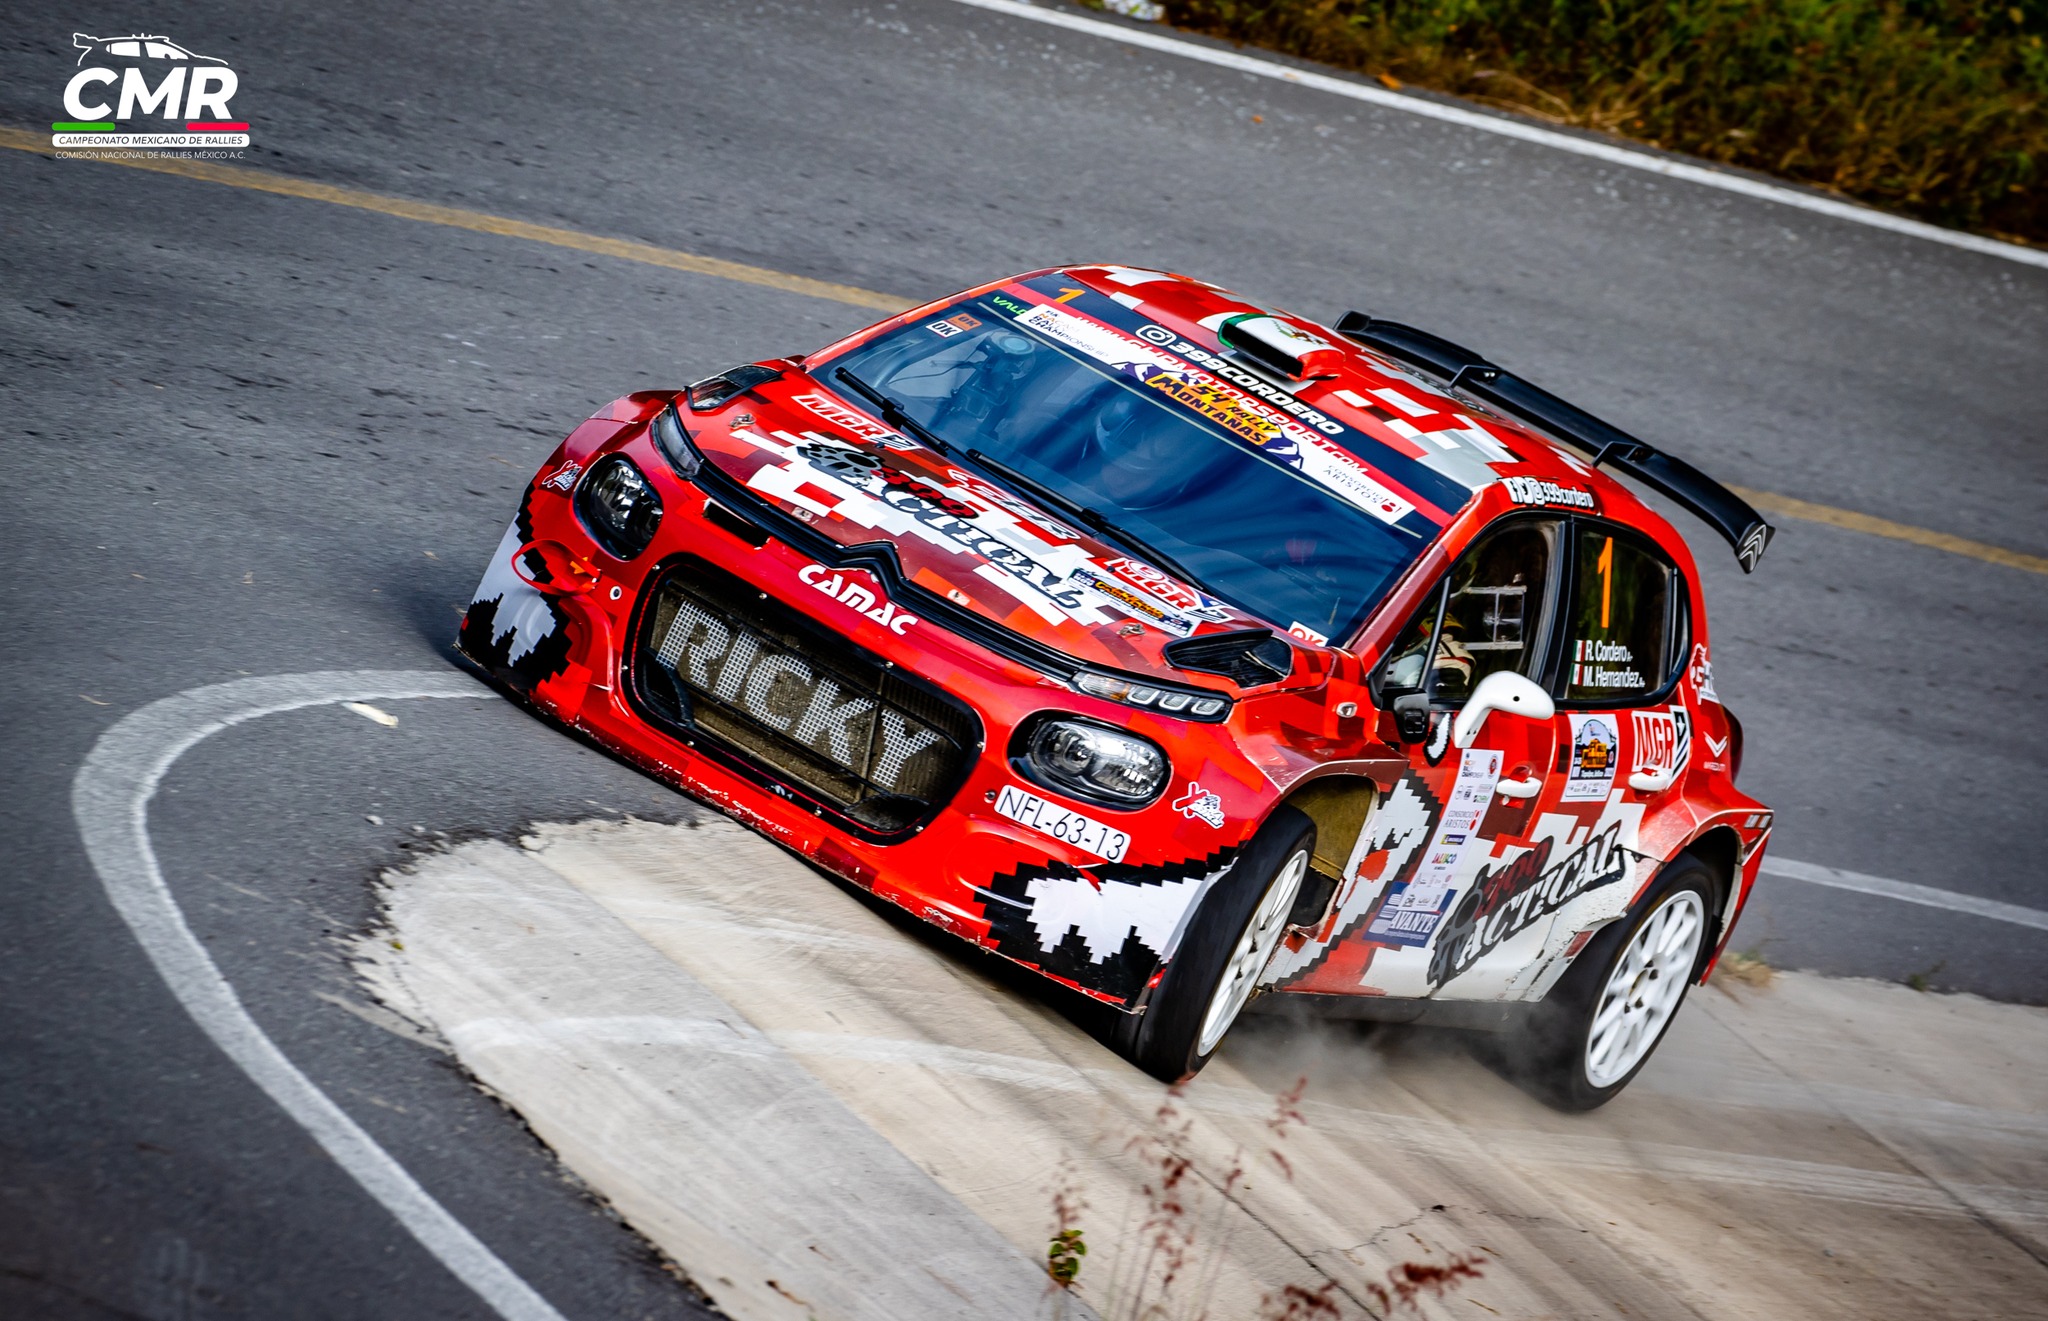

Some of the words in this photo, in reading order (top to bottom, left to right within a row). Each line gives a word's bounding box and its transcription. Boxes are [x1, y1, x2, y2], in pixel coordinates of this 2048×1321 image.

[1053, 287, 1086, 304] 1
[932, 322, 957, 336] OK
[1028, 319, 1110, 358] CHAMPIONSHIP
[1169, 341, 1344, 435] 399CORDERO
[1149, 375, 1268, 444] MONTAÑAS
[1227, 405, 1279, 432] RALLY
[1323, 469, 1378, 505] ARISTOS
[1328, 465, 1384, 500] CONSORCIO
[798, 564, 918, 636] CAMAC
[1597, 536, 1613, 629] 1
[1585, 639, 1594, 661] R.
[1595, 639, 1628, 662] Cordero
[655, 600, 940, 788] RICKY
[1583, 665, 1594, 687] M.
[1595, 665, 1639, 688] Hernandez
[998, 787, 1126, 861] NFL-63-13
[1390, 910, 1439, 934] AVANTE
